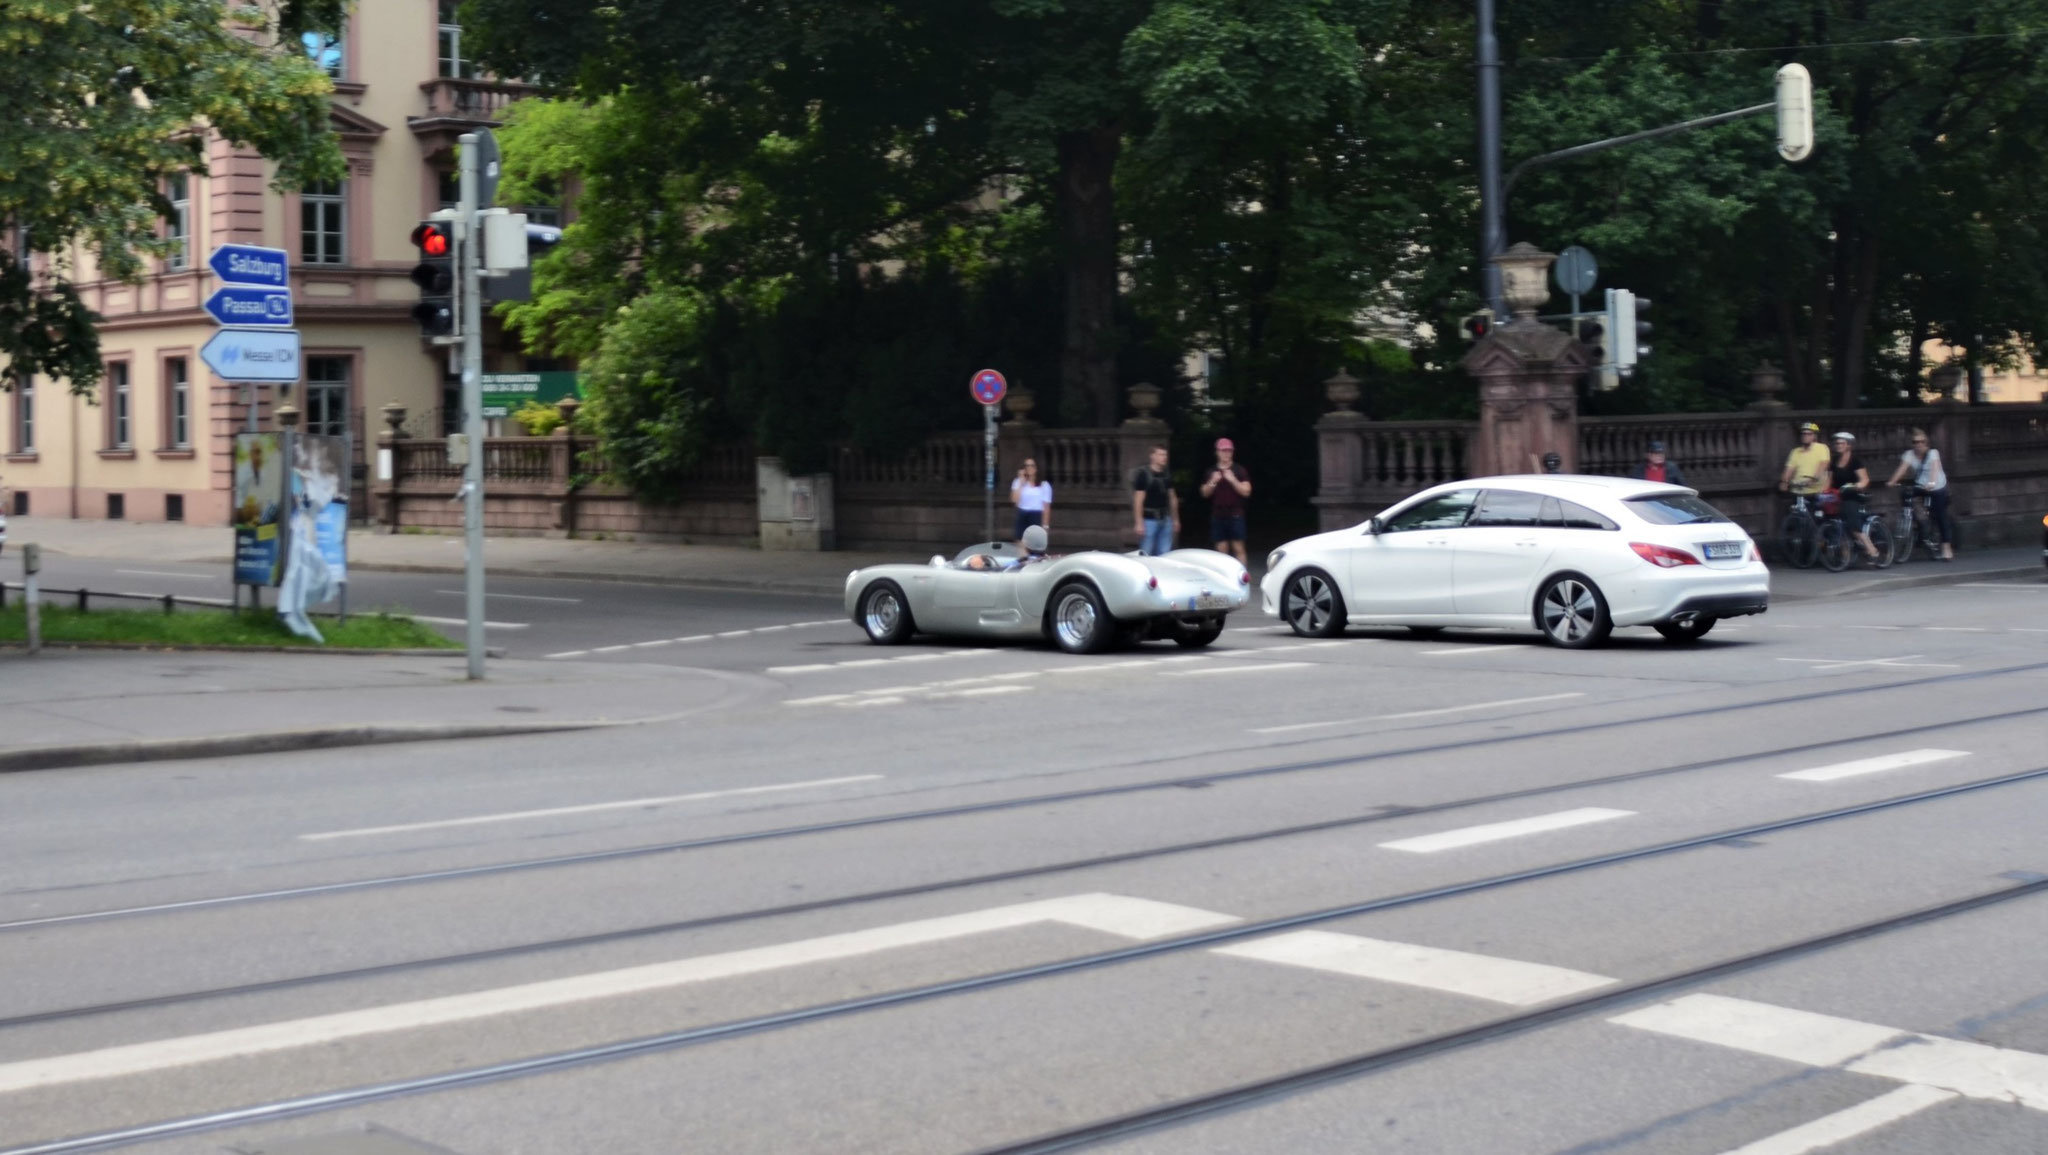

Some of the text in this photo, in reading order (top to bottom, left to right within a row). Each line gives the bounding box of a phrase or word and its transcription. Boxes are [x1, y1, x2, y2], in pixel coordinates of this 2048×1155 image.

[228, 253, 282, 281] Salzburg
[222, 296, 267, 314] Passau
[243, 348, 274, 362] Messe
[496, 374, 541, 383] VERMIETEN
